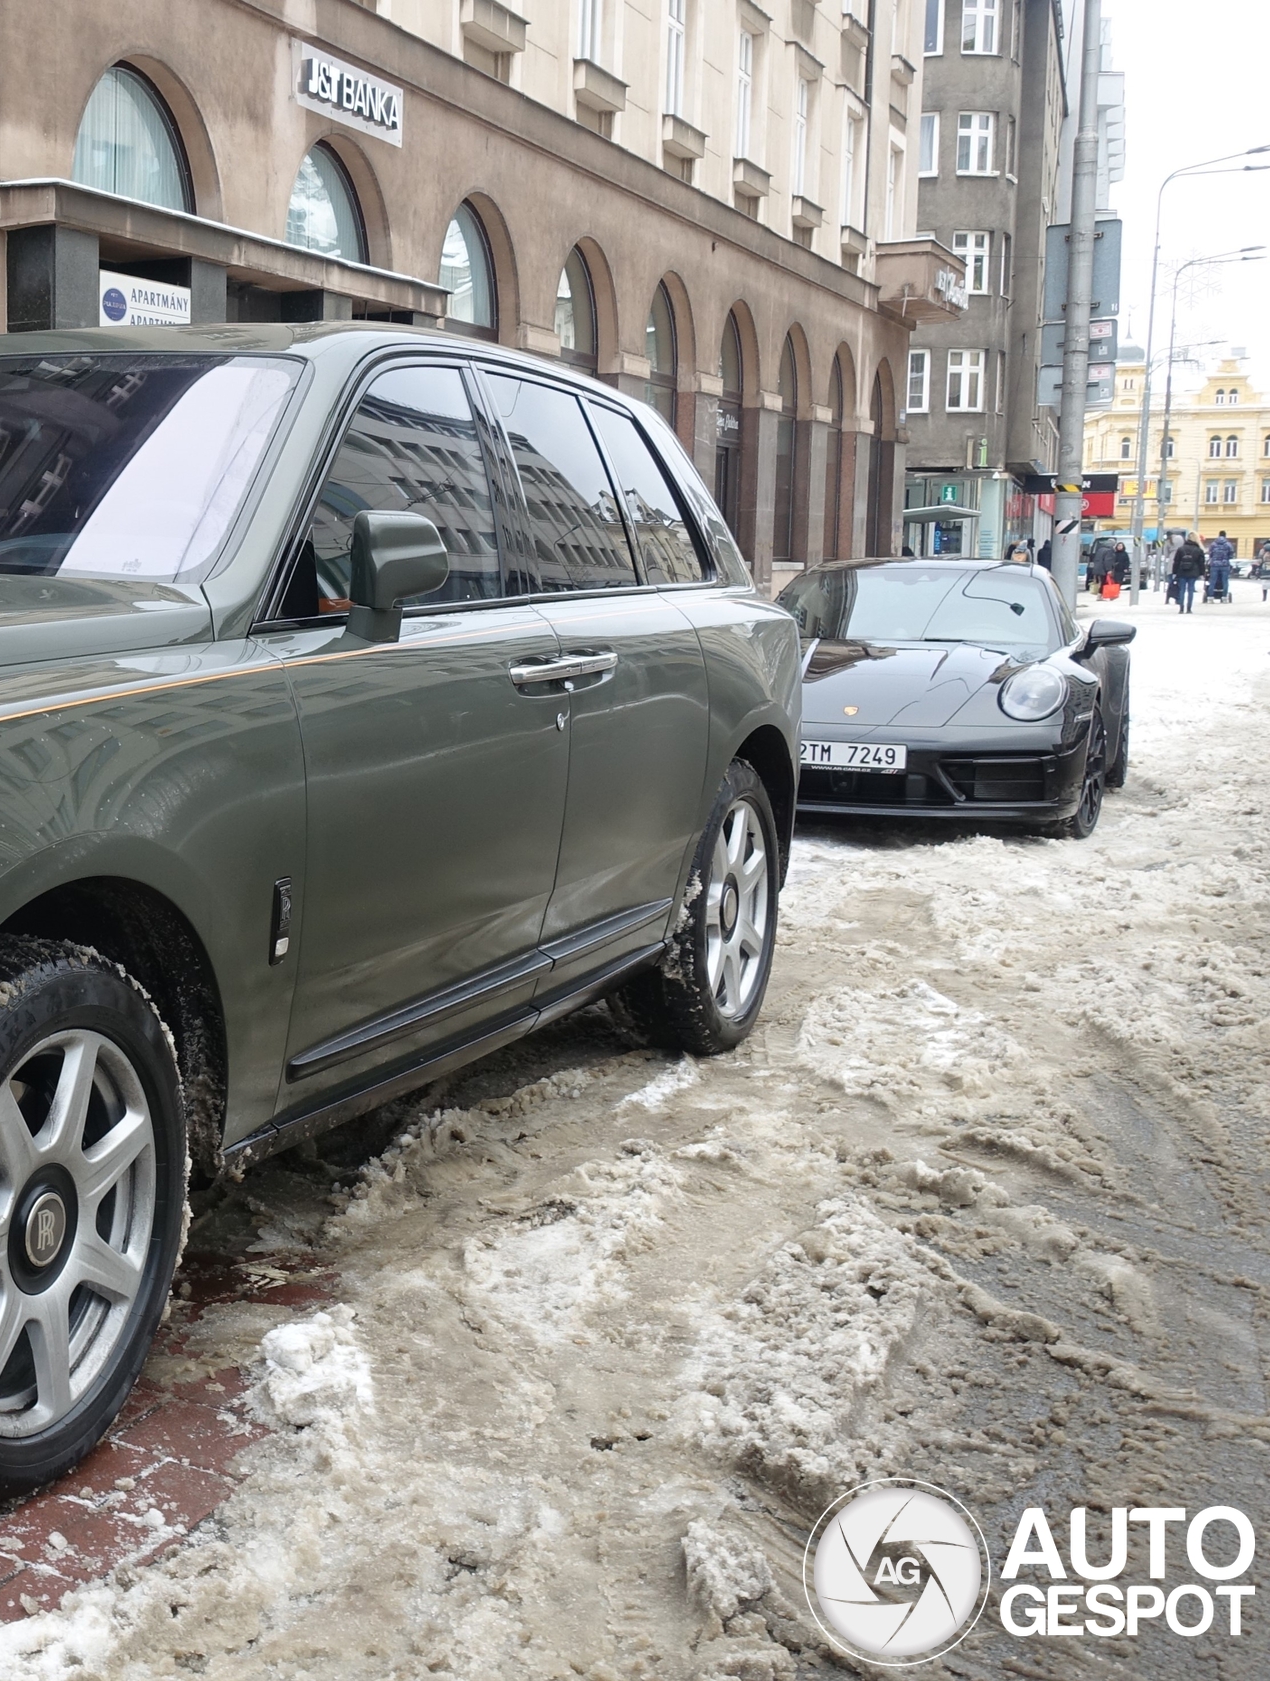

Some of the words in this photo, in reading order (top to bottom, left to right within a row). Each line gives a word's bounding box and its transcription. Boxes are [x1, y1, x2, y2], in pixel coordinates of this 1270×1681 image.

[309, 57, 341, 103] J&T
[342, 72, 400, 130] BANKA
[130, 287, 189, 312] APARTMÁNY
[847, 745, 896, 765] 7249
